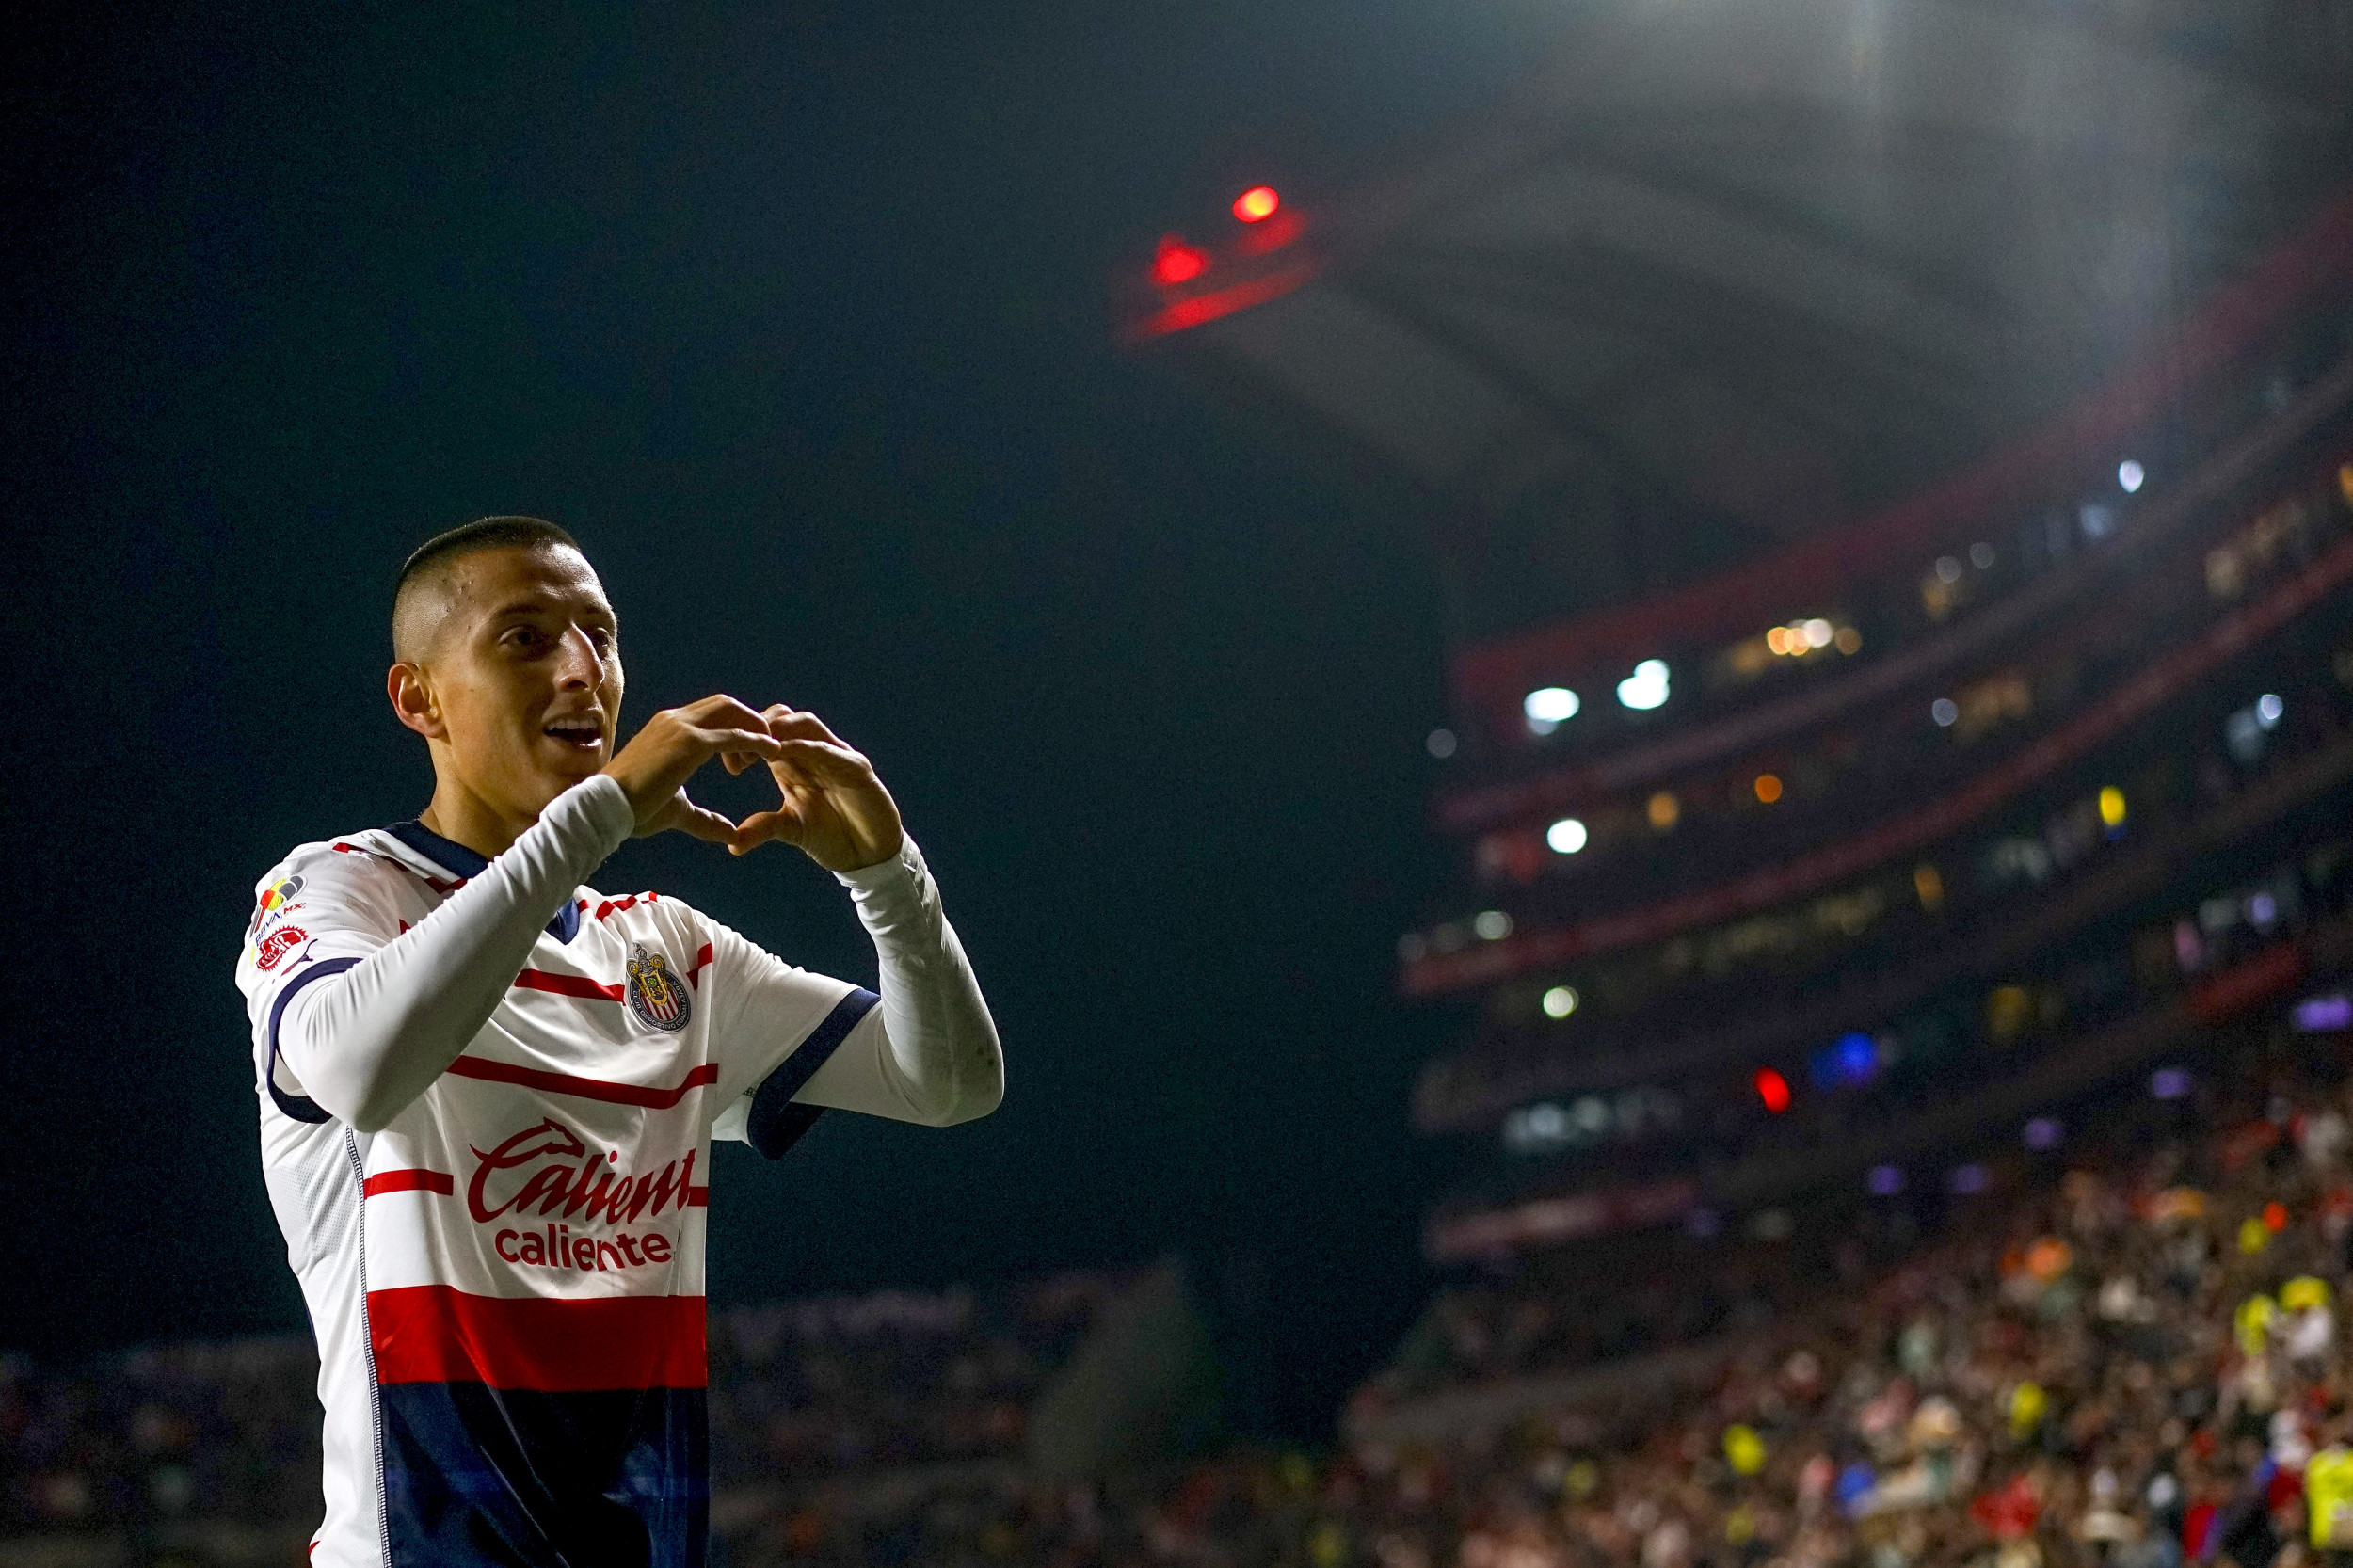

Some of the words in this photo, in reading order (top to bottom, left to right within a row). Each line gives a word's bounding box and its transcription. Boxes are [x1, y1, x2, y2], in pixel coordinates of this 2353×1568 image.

[255, 912, 281, 947] BBVA
[283, 903, 303, 915] MX
[468, 1116, 696, 1224] Calient
[495, 1224, 671, 1271] caliente
